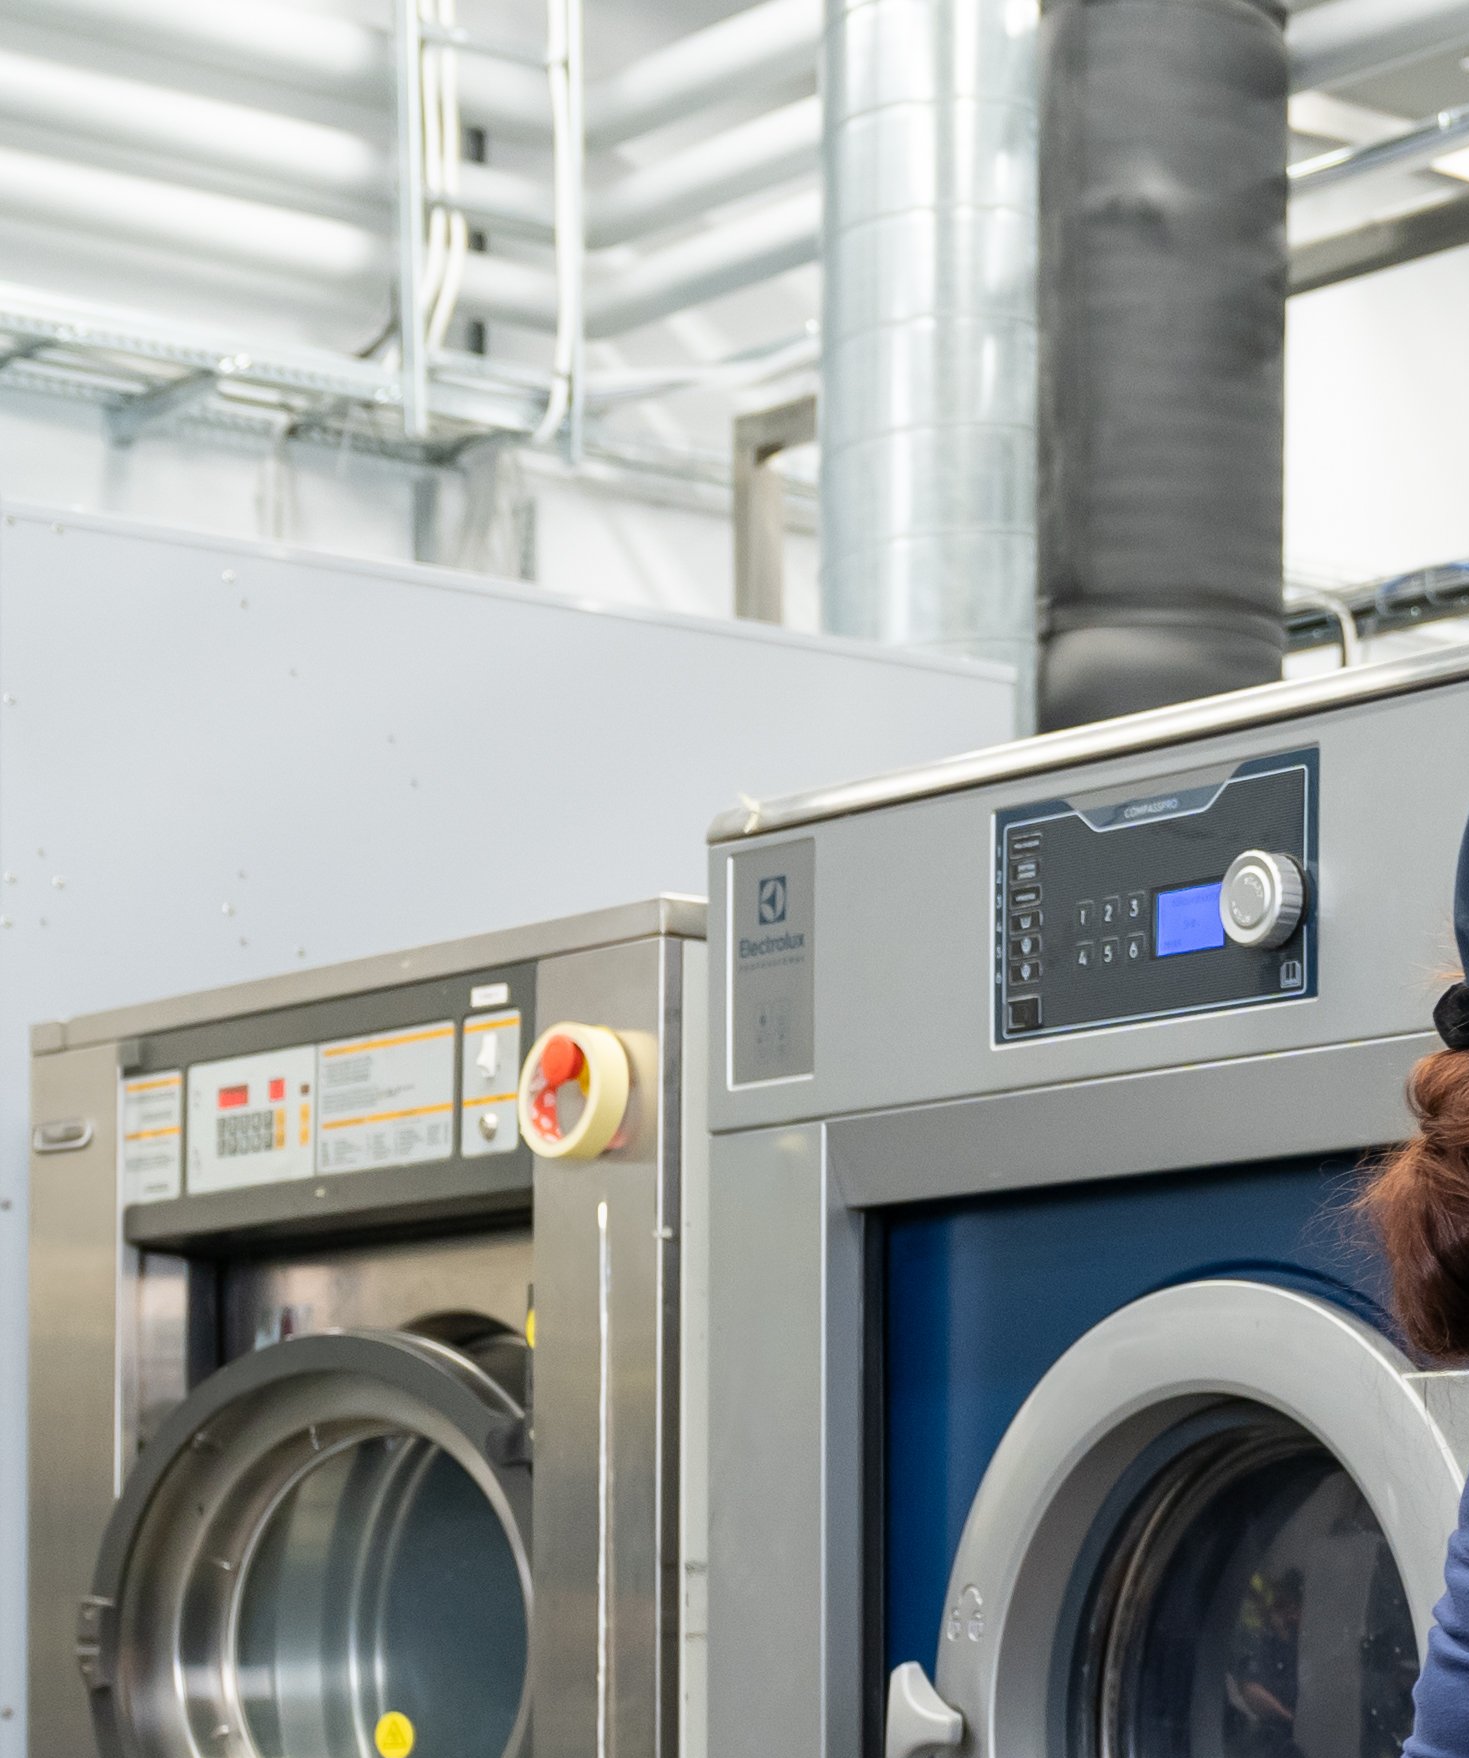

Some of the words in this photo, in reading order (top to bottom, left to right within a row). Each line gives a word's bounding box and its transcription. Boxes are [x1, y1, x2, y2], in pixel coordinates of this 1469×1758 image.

[1080, 909, 1086, 926] 1
[1104, 903, 1113, 922] 2
[1129, 898, 1139, 917] 3
[1078, 950, 1088, 966] 4
[1103, 944, 1113, 963] 5
[1129, 941, 1138, 959] 6
